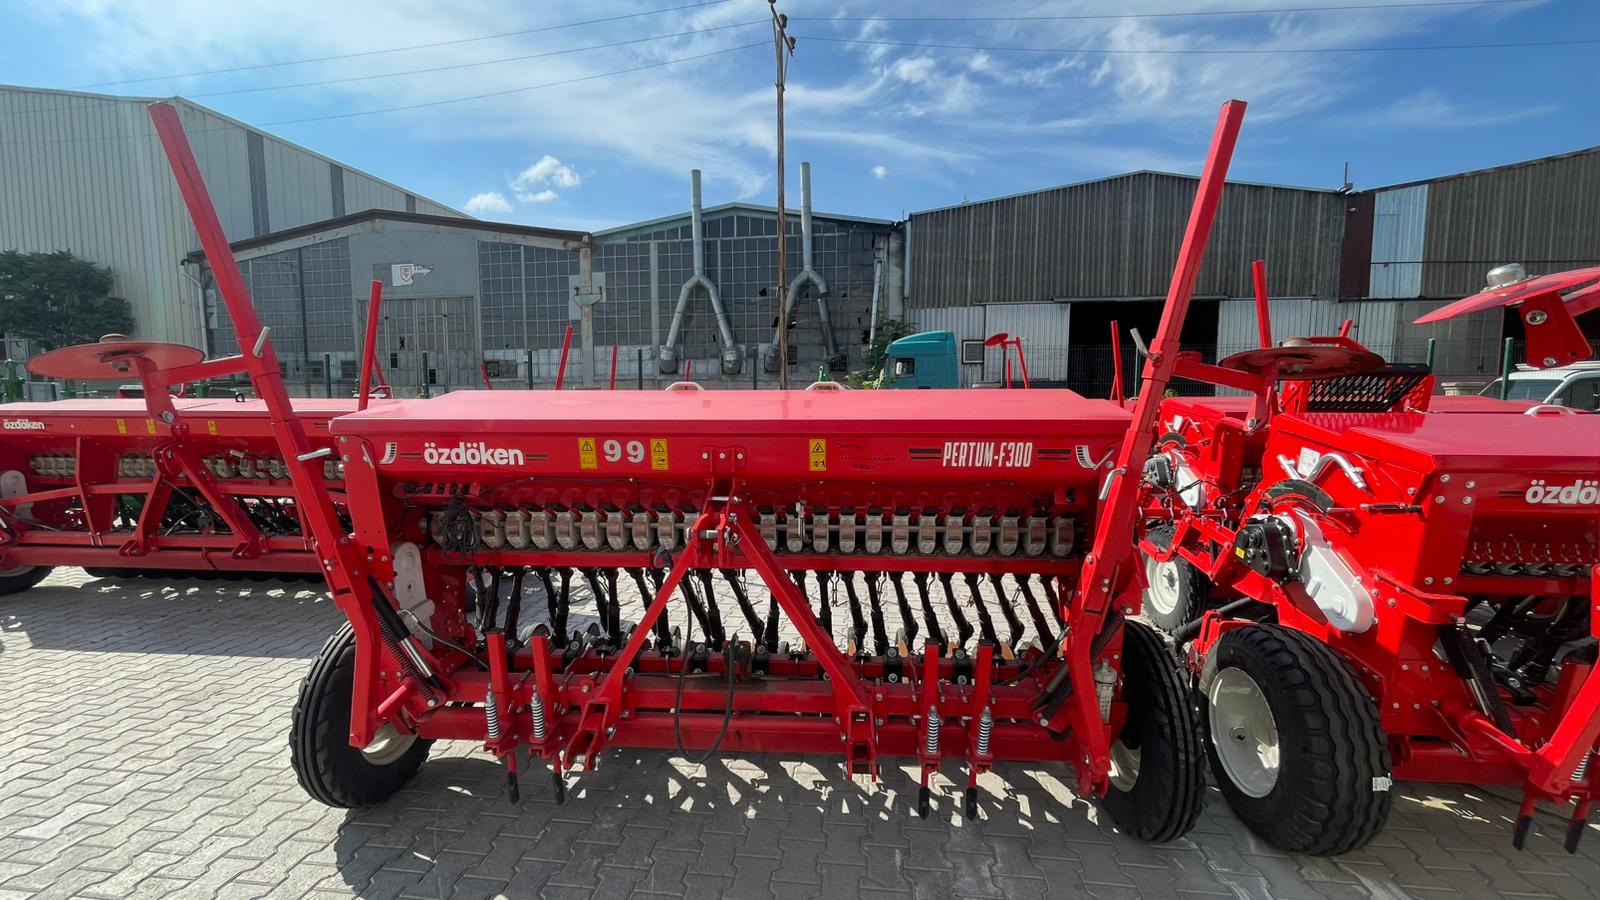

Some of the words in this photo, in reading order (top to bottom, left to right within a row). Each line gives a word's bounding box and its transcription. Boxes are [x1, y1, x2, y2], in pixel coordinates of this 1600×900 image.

[3, 418, 45, 430] özdöken
[424, 442, 524, 466] özdöken
[603, 439, 645, 464] 99
[942, 442, 1033, 467] PERTUM-F300
[1525, 480, 1600, 505] özdö
